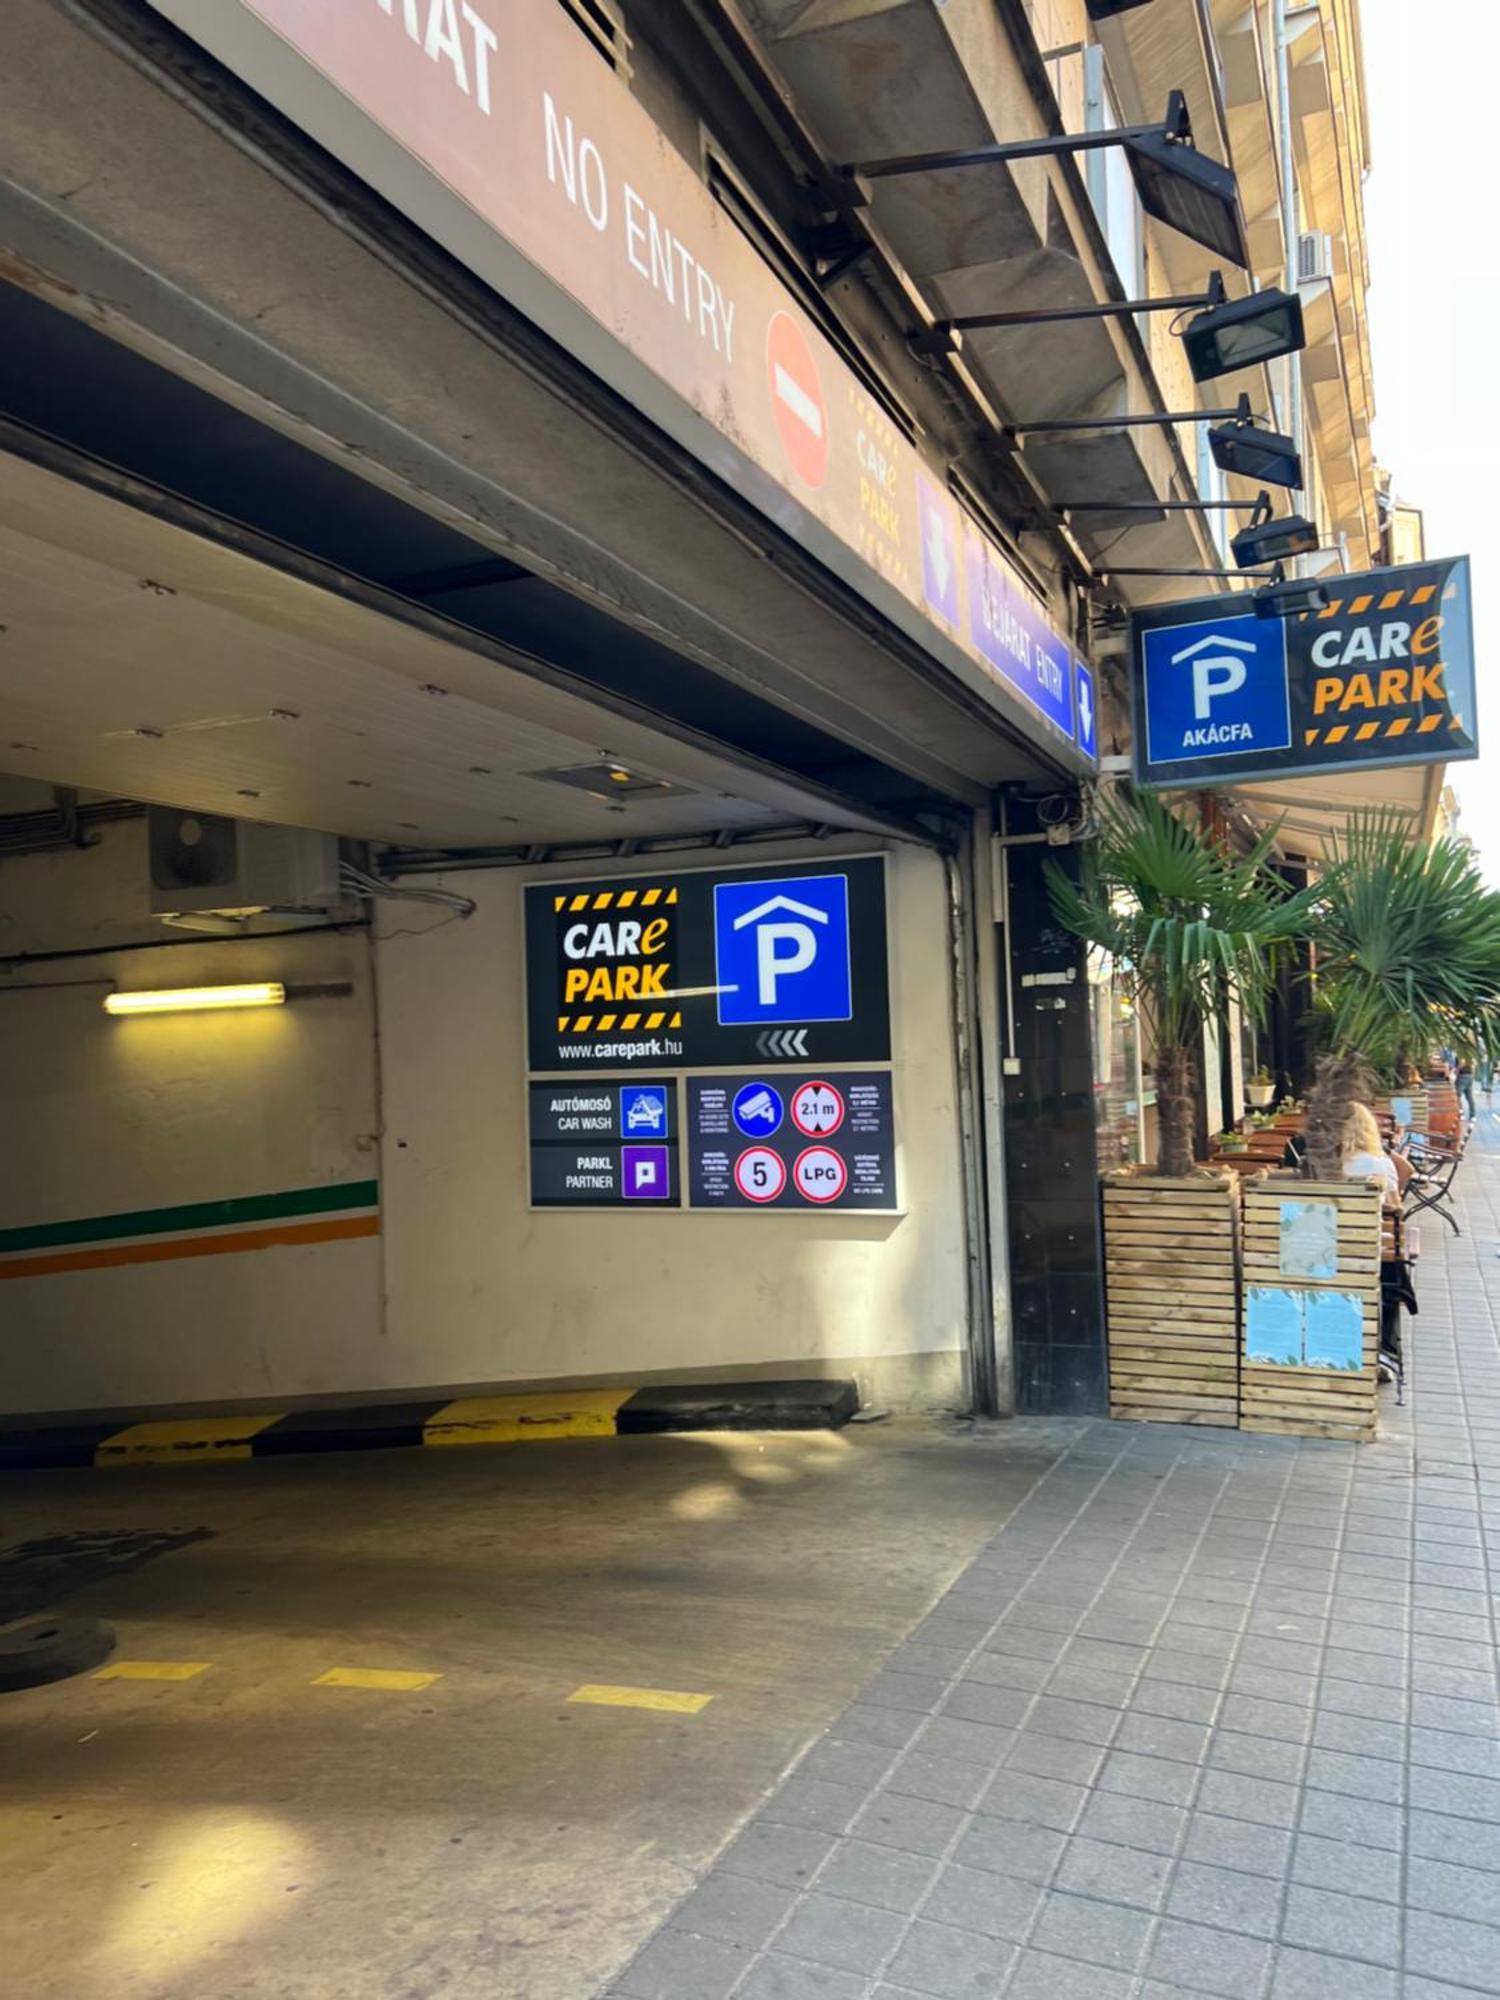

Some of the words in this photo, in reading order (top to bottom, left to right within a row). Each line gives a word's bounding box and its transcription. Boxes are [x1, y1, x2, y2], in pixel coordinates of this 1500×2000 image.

[543, 91, 608, 231] NO
[623, 182, 735, 364] ENTRY
[860, 475, 901, 547] PARK
[1036, 643, 1063, 704] ENTRY
[1192, 655, 1248, 720] P
[1312, 661, 1448, 715] PARK
[1182, 722, 1253, 747] AKÁCFA
[756, 922, 818, 1006] P
[564, 963, 670, 1003] PARK
[558, 1038, 683, 1060] www.carepark.hu
[550, 1096, 612, 1112] AUTÓMOSÓ
[801, 1103, 818, 1115] 2.1
[822, 1104, 835, 1115] m
[558, 1118, 580, 1130] CAR
[581, 1117, 612, 1130] WASH
[576, 1157, 613, 1170] PARKL
[753, 1162, 767, 1187] 5
[804, 1168, 837, 1180] LPG
[566, 1176, 613, 1189] PARTNER
